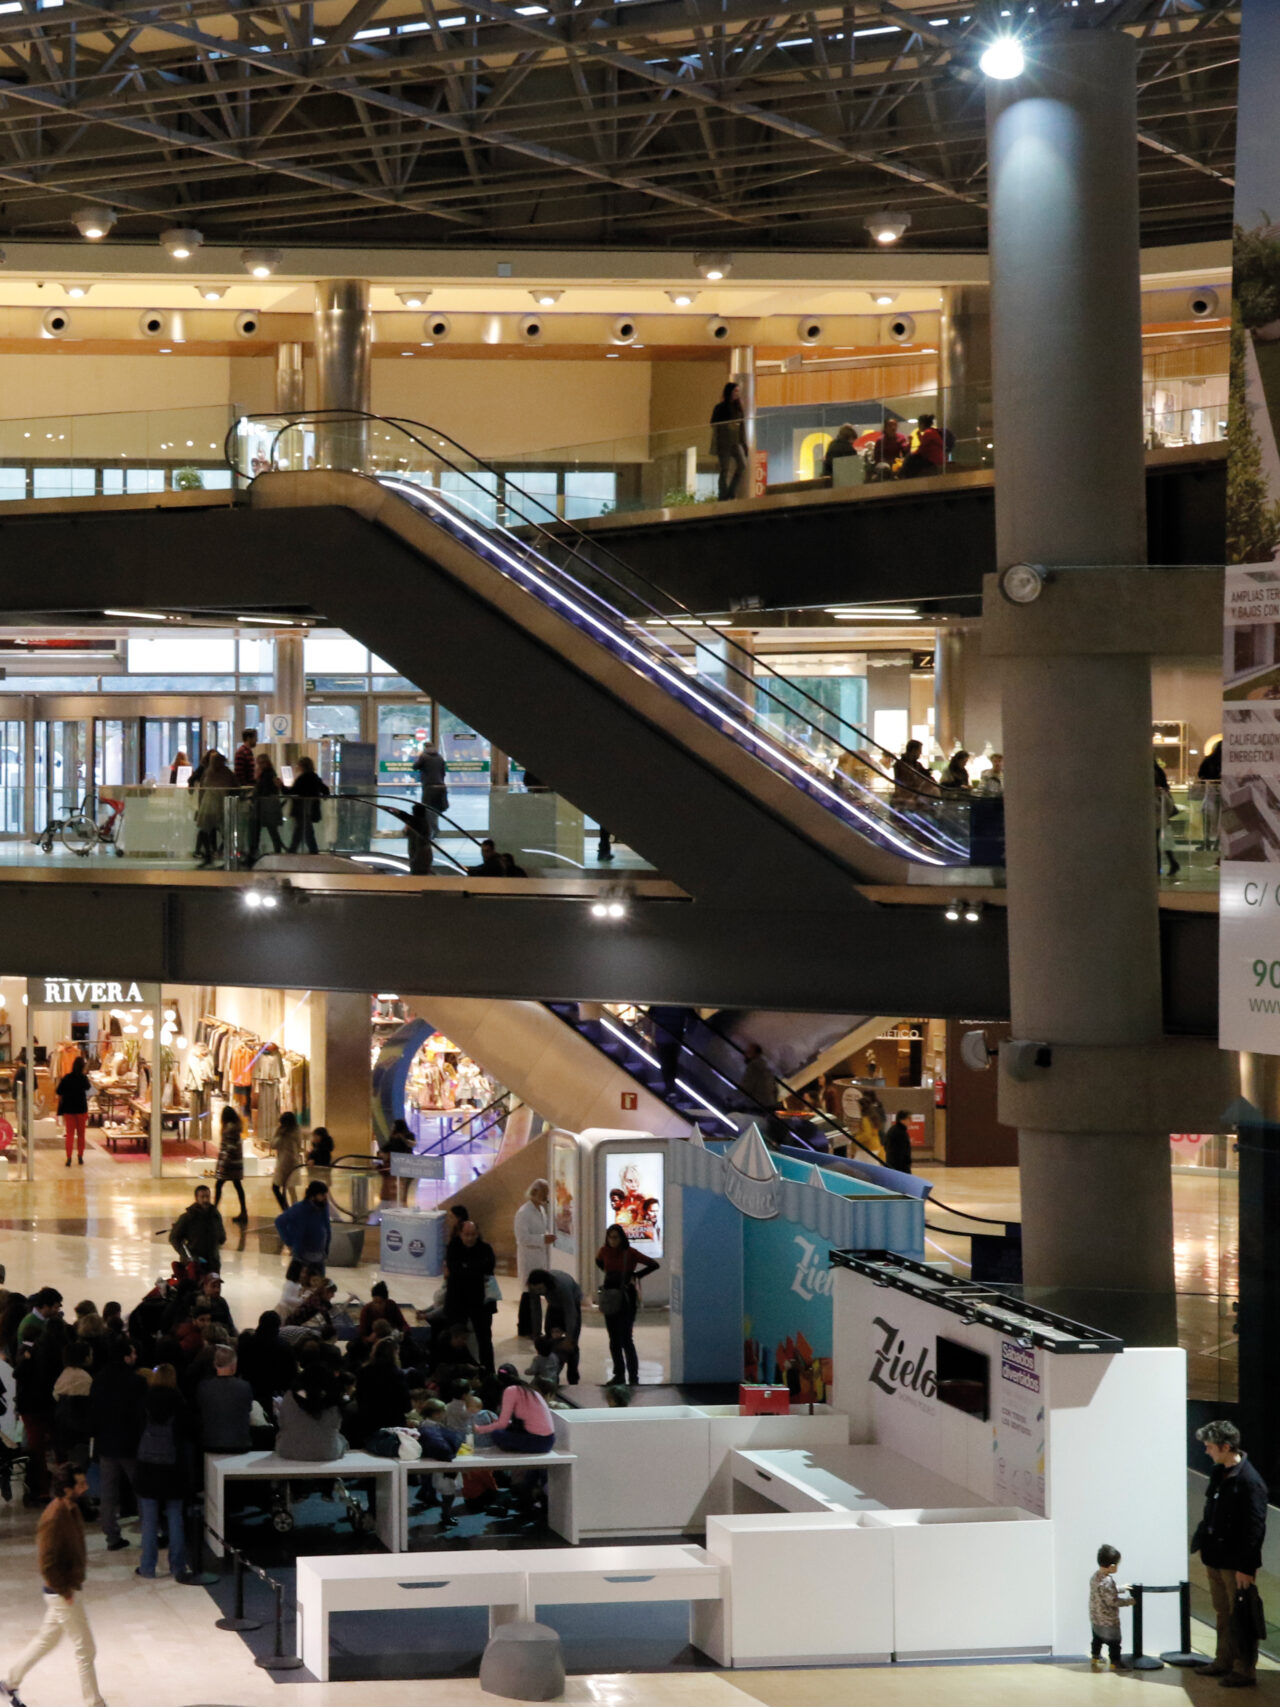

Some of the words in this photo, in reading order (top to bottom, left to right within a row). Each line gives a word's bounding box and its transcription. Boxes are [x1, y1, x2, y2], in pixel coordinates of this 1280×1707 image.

[920, 656, 935, 667] Z
[44, 982, 144, 1003] RIVERA
[869, 1316, 937, 1398] Zielo
